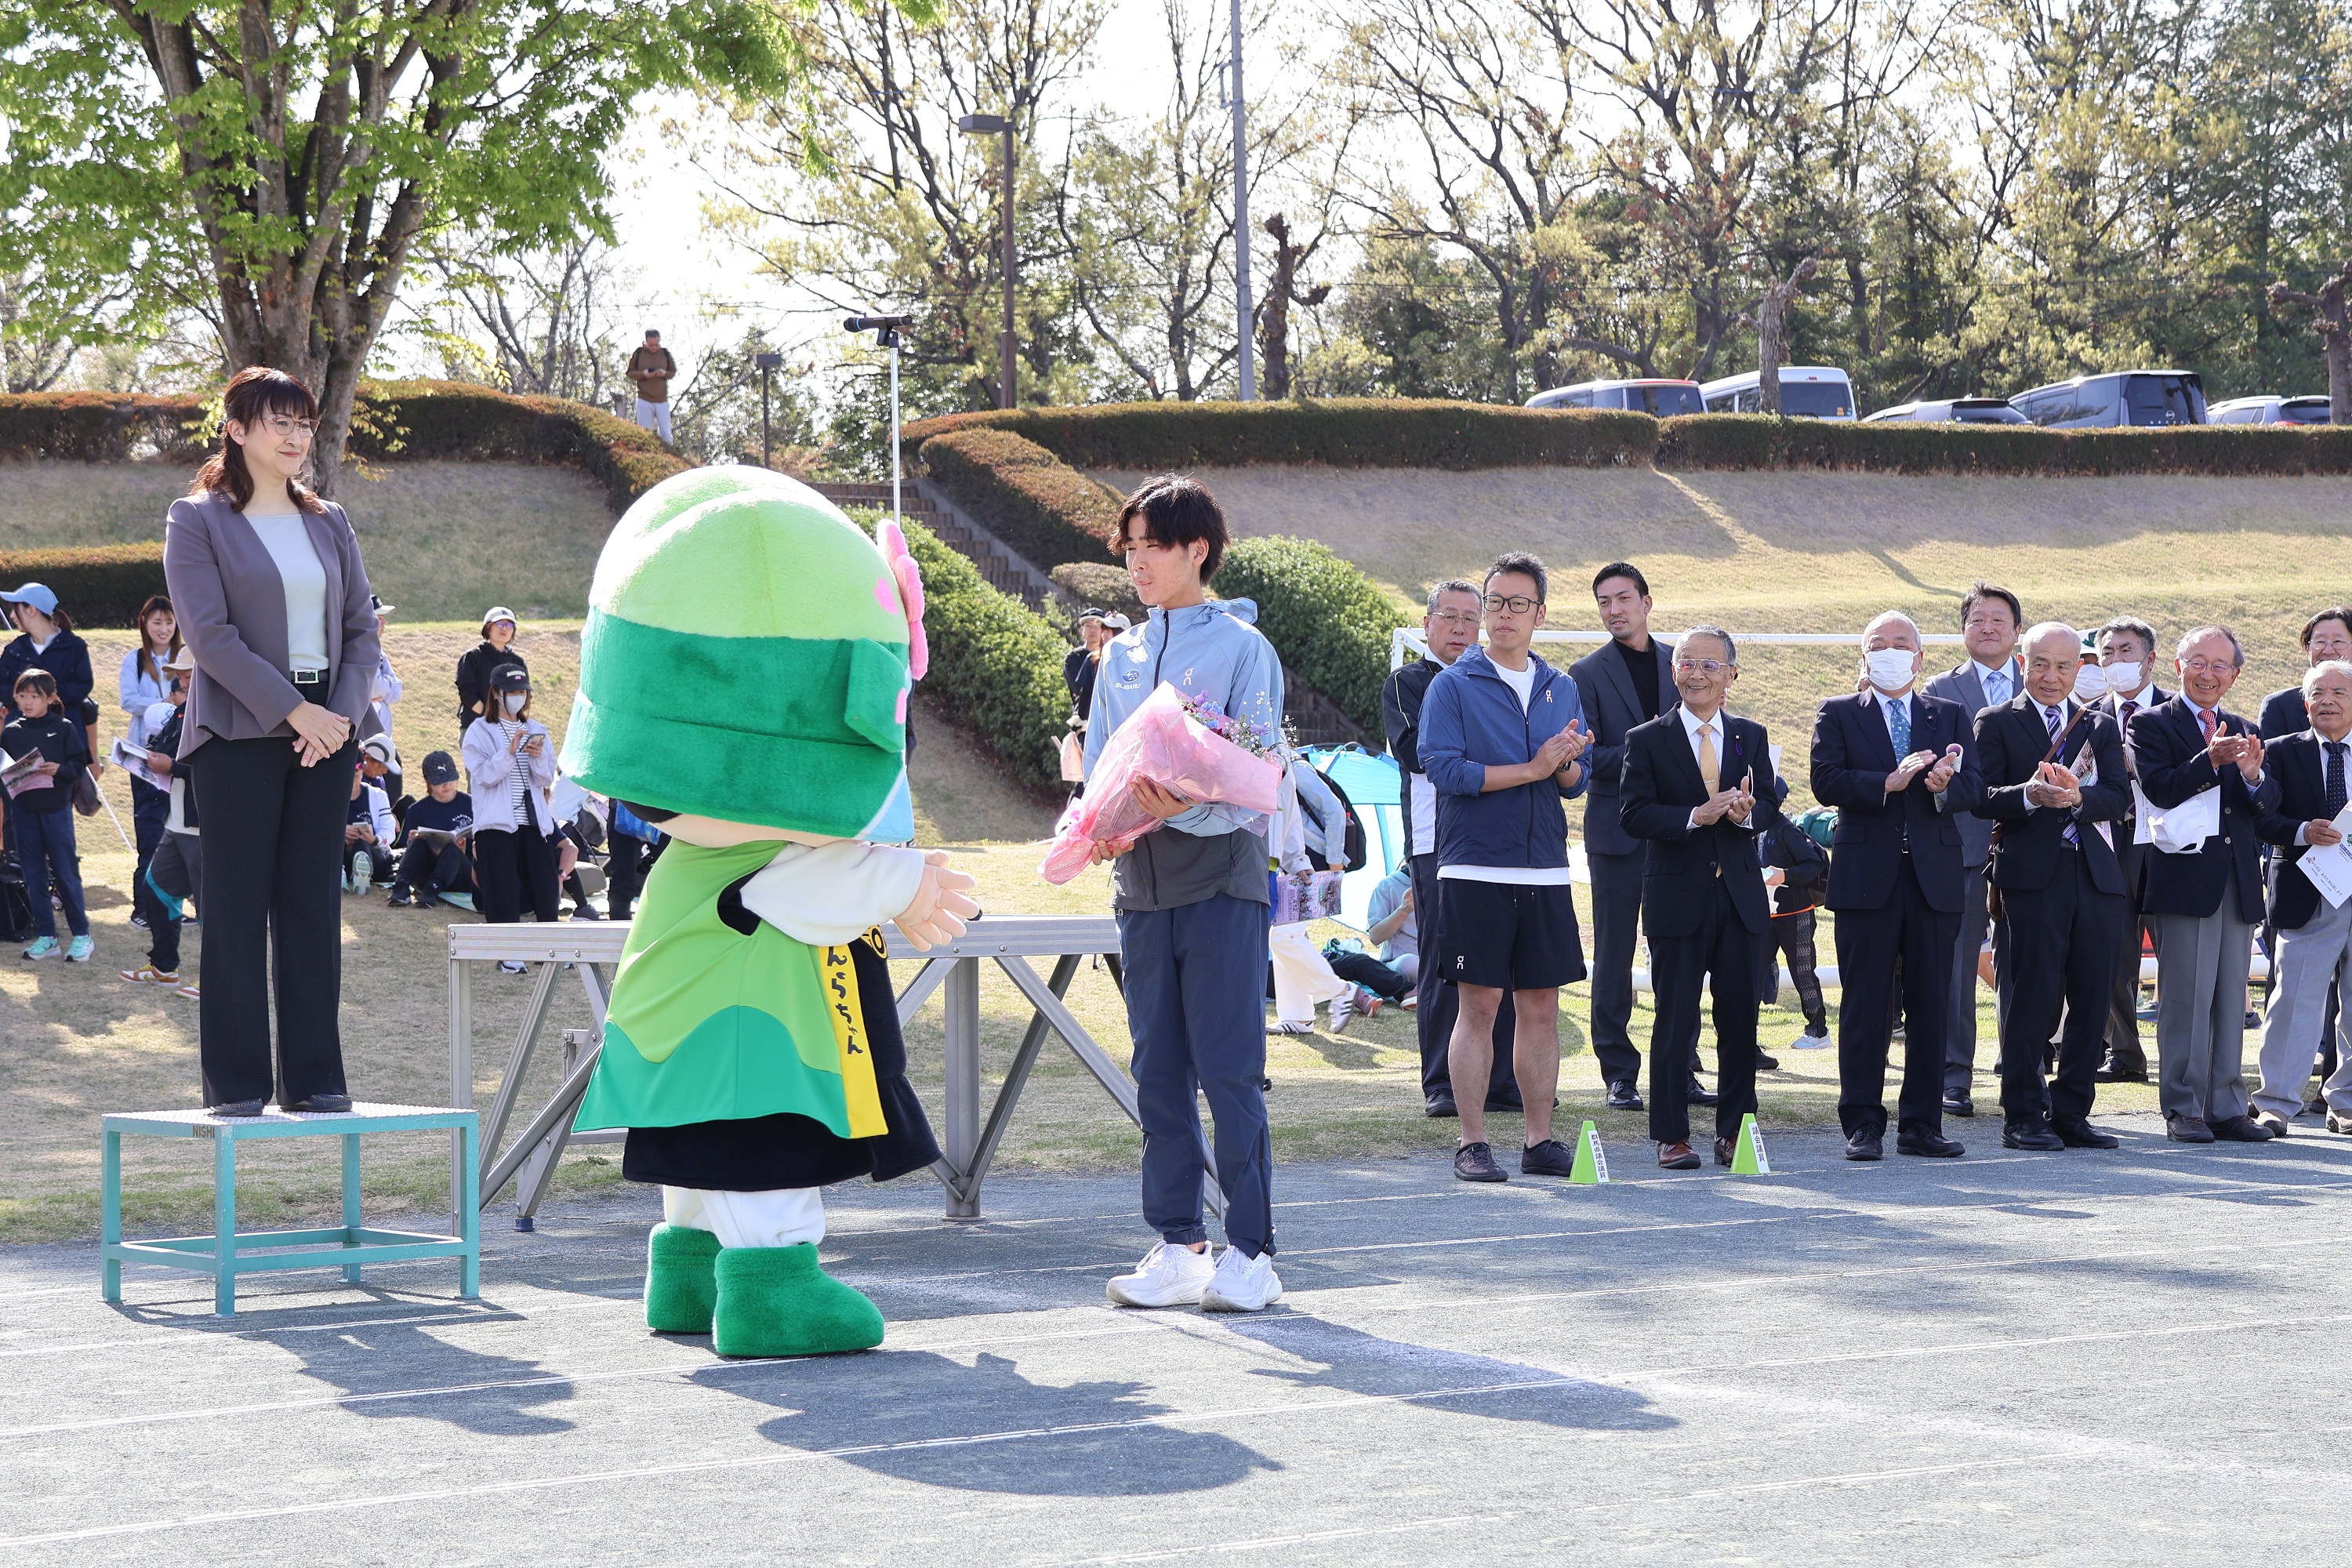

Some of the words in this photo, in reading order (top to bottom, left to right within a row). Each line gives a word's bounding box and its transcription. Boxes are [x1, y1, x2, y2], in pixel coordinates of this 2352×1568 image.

[1591, 1134, 1606, 1179] 群馬県議会議員
[1751, 1126, 1766, 1163] 議会議員
